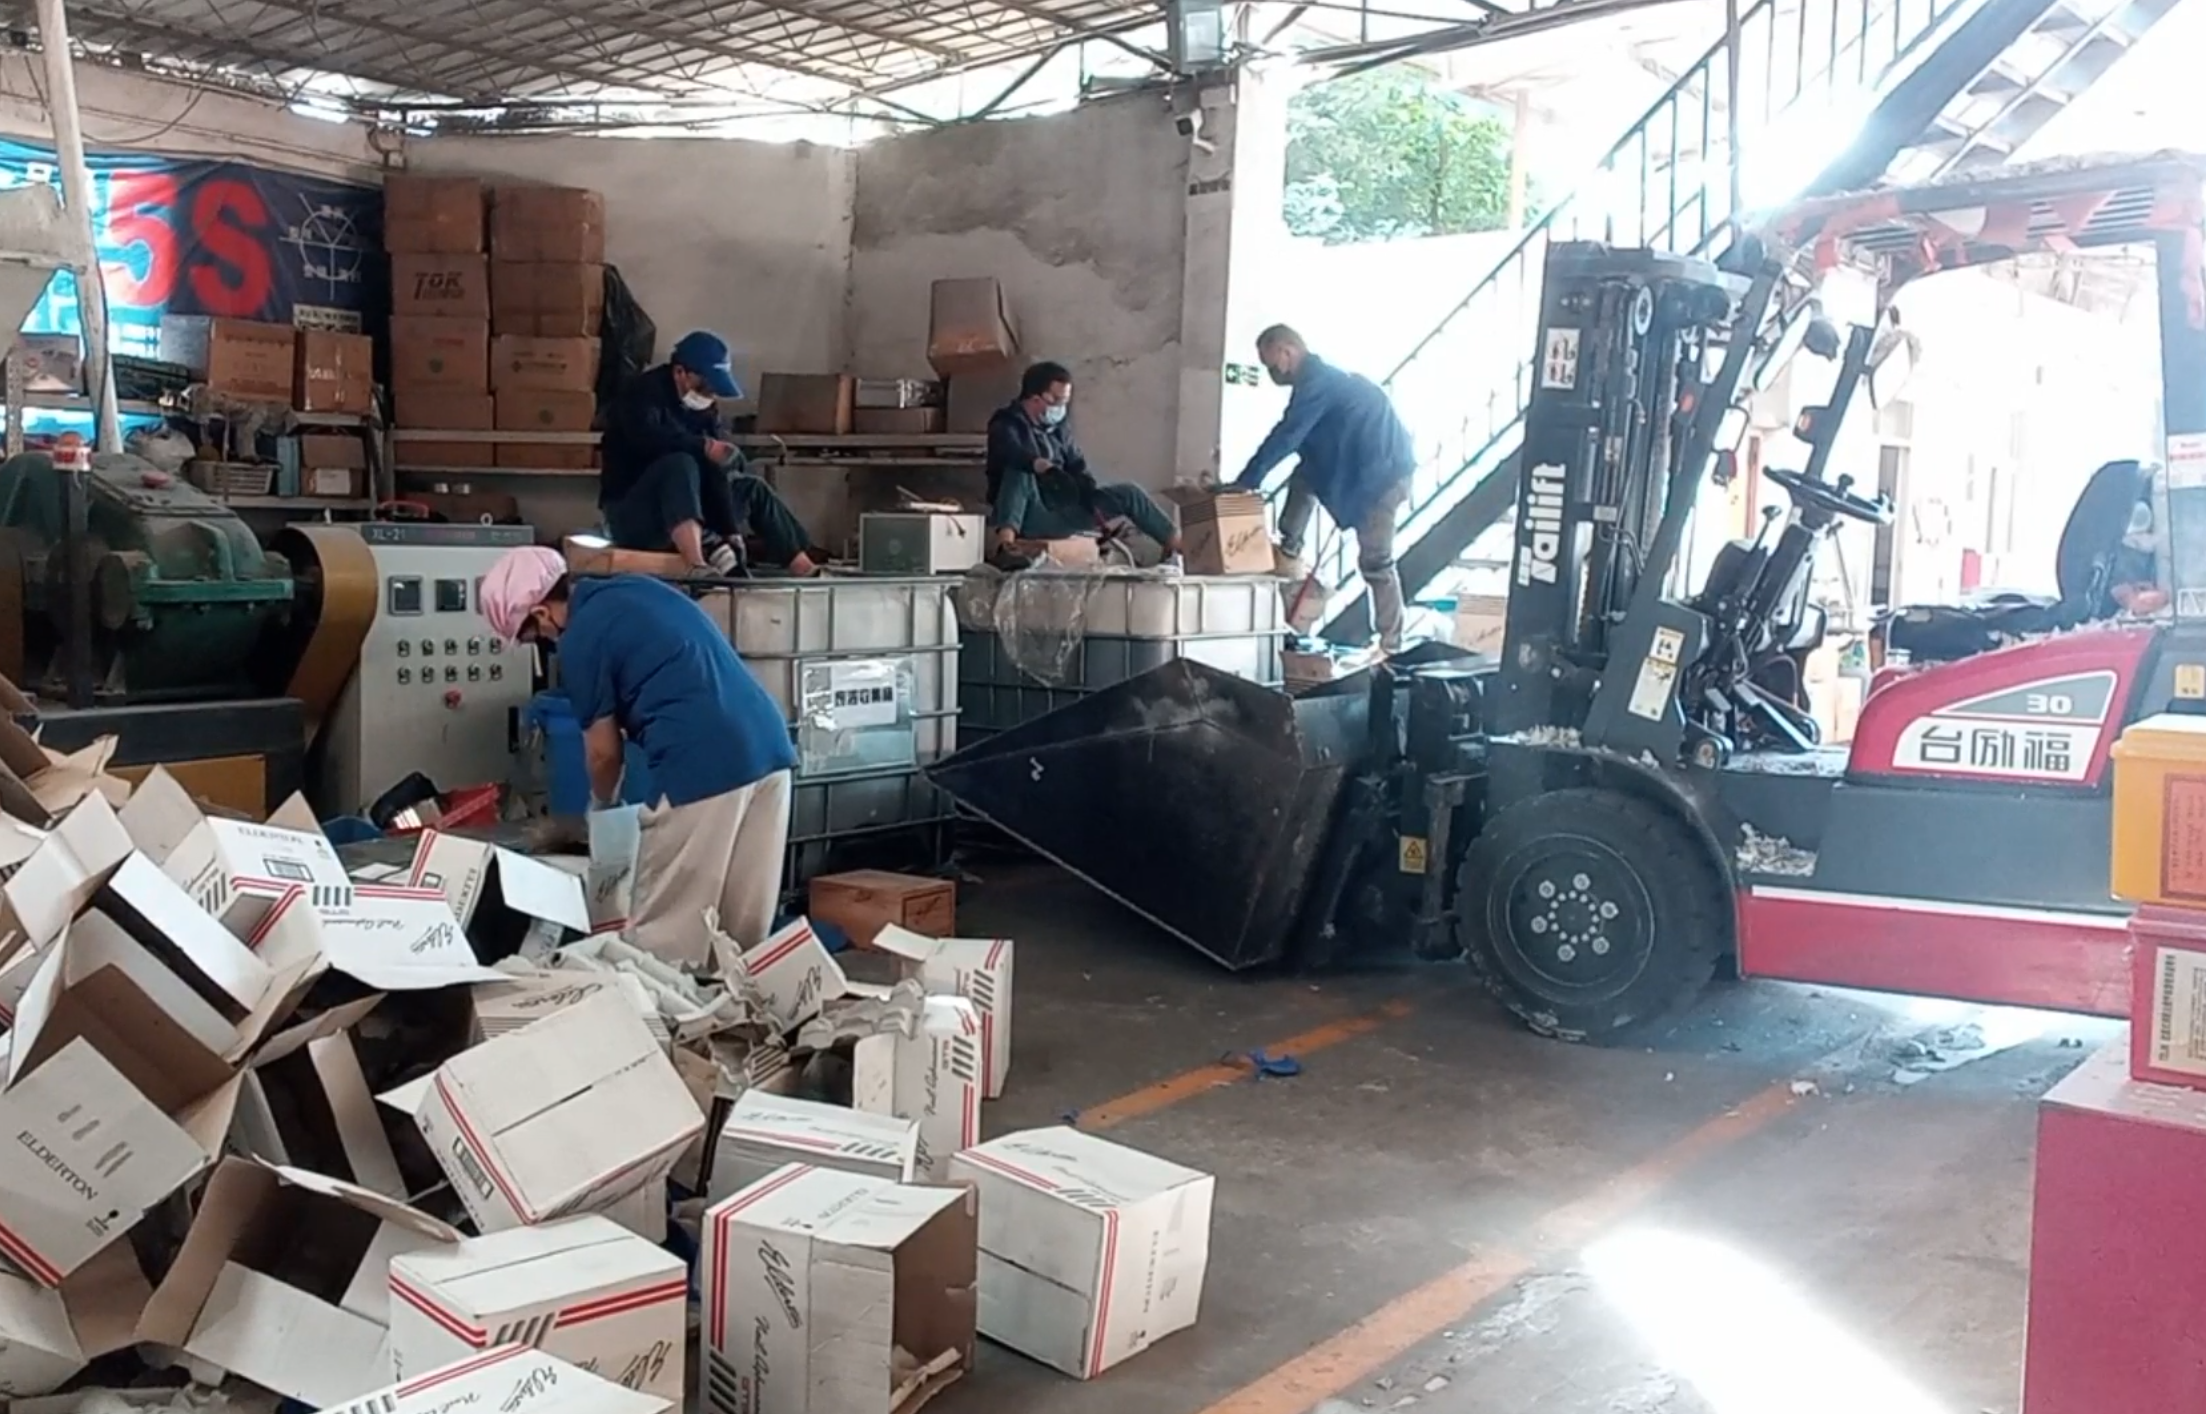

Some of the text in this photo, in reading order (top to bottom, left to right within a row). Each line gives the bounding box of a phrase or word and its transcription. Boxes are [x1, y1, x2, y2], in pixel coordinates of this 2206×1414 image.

[103, 170, 272, 317] 5S
[1517, 462, 1566, 587] Tailift
[2027, 693, 2072, 714] 30
[1920, 725, 2072, 772] 台励福
[17, 1129, 99, 1201] ELDERTON
